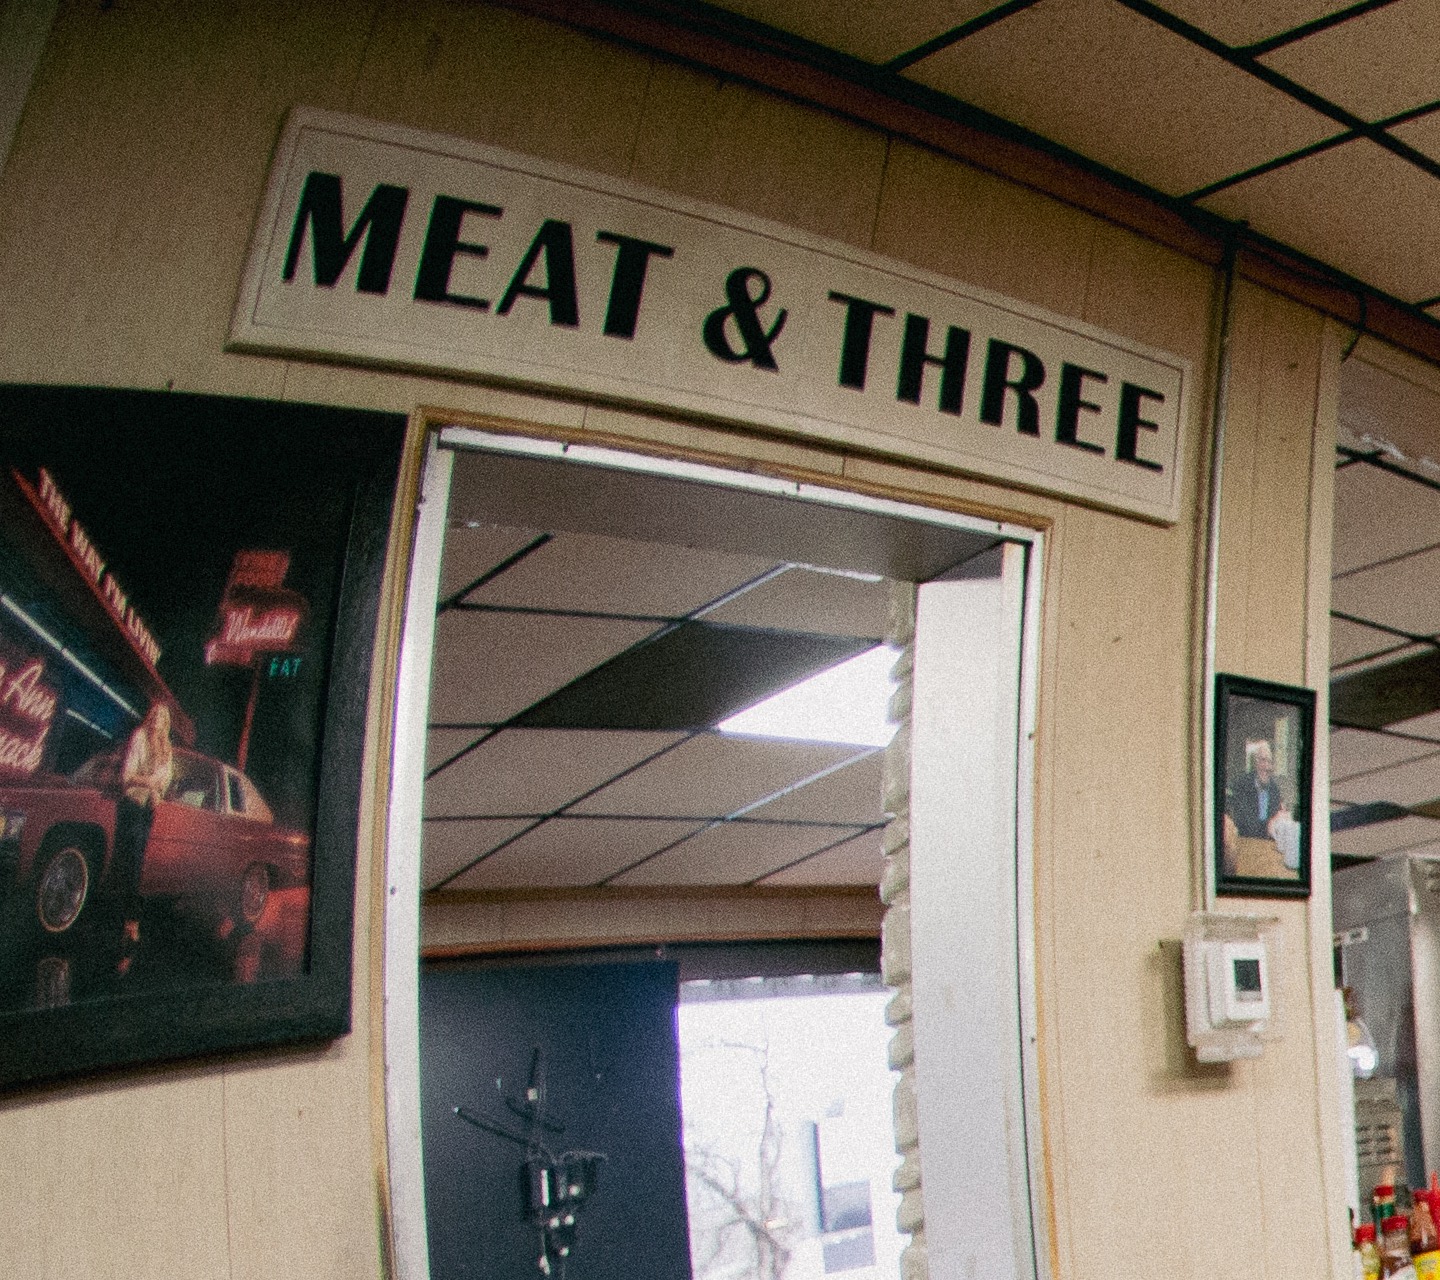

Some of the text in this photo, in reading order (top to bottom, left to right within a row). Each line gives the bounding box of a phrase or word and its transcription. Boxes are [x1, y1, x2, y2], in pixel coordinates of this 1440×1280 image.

[282, 170, 1166, 472] MEAT & THREE
